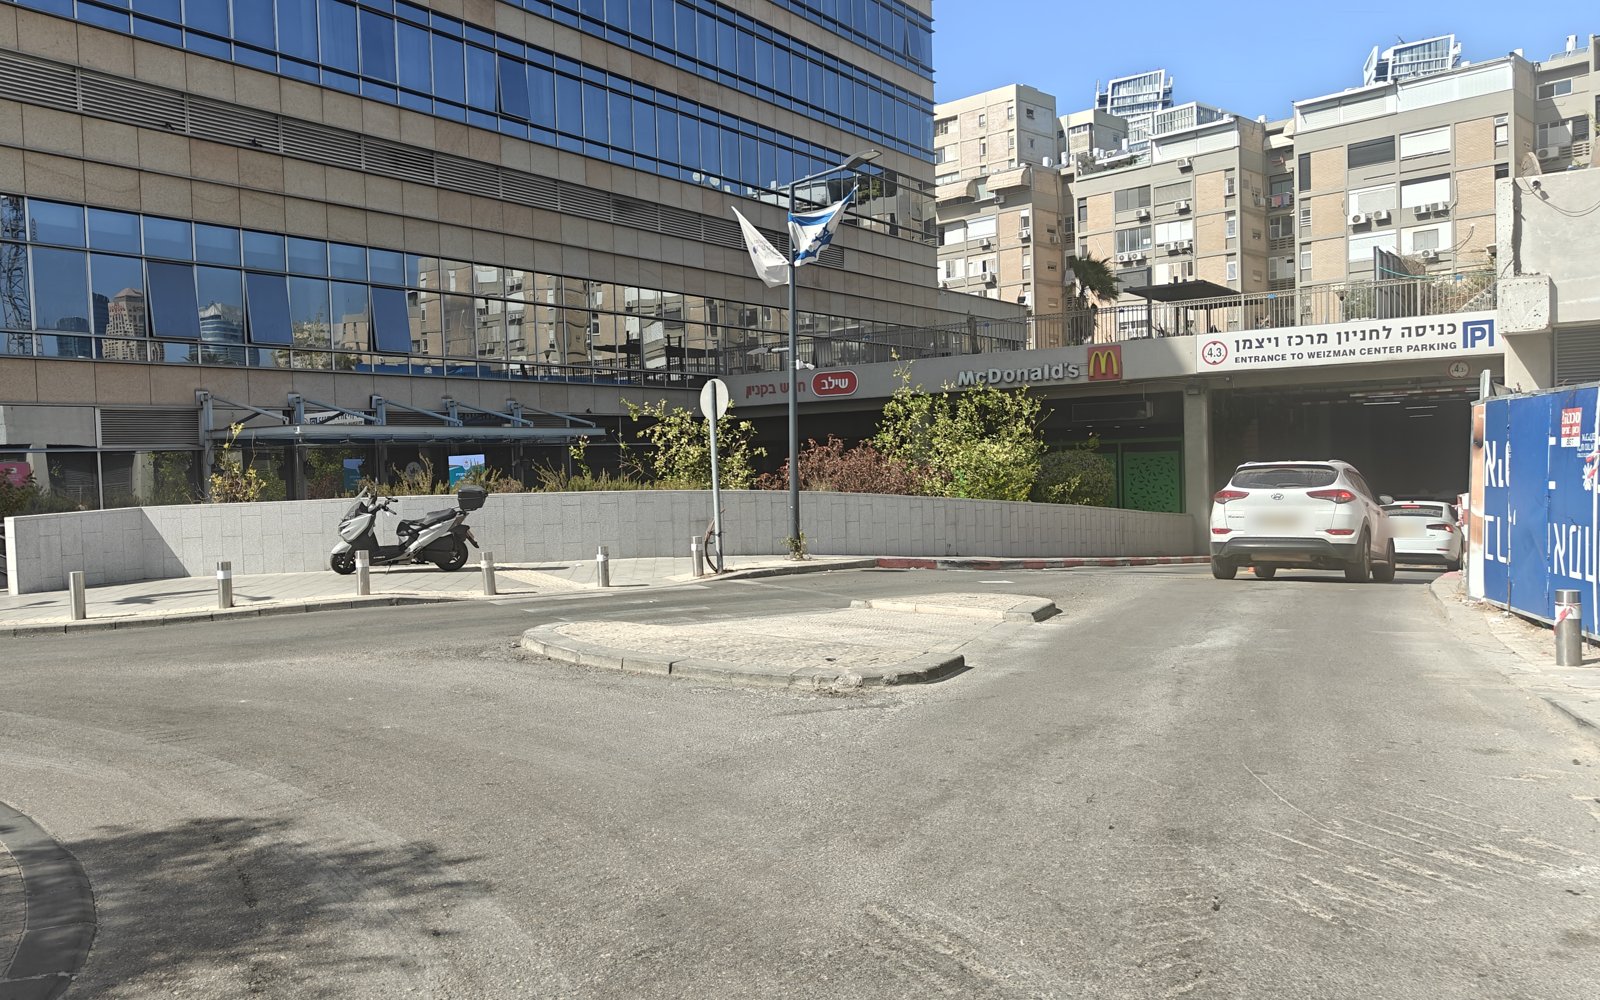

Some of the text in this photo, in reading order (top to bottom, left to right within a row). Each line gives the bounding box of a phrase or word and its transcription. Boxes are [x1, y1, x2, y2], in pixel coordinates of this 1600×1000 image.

[1234, 323, 1457, 352] כניסה לחניון מרכז ויצמן
[1234, 342, 1457, 363] ENTRANCE TO WEIZMAN CENTER PARKING
[820, 376, 849, 390] שילב
[958, 362, 1080, 386] McDonald's
[780, 381, 806, 393] חש
